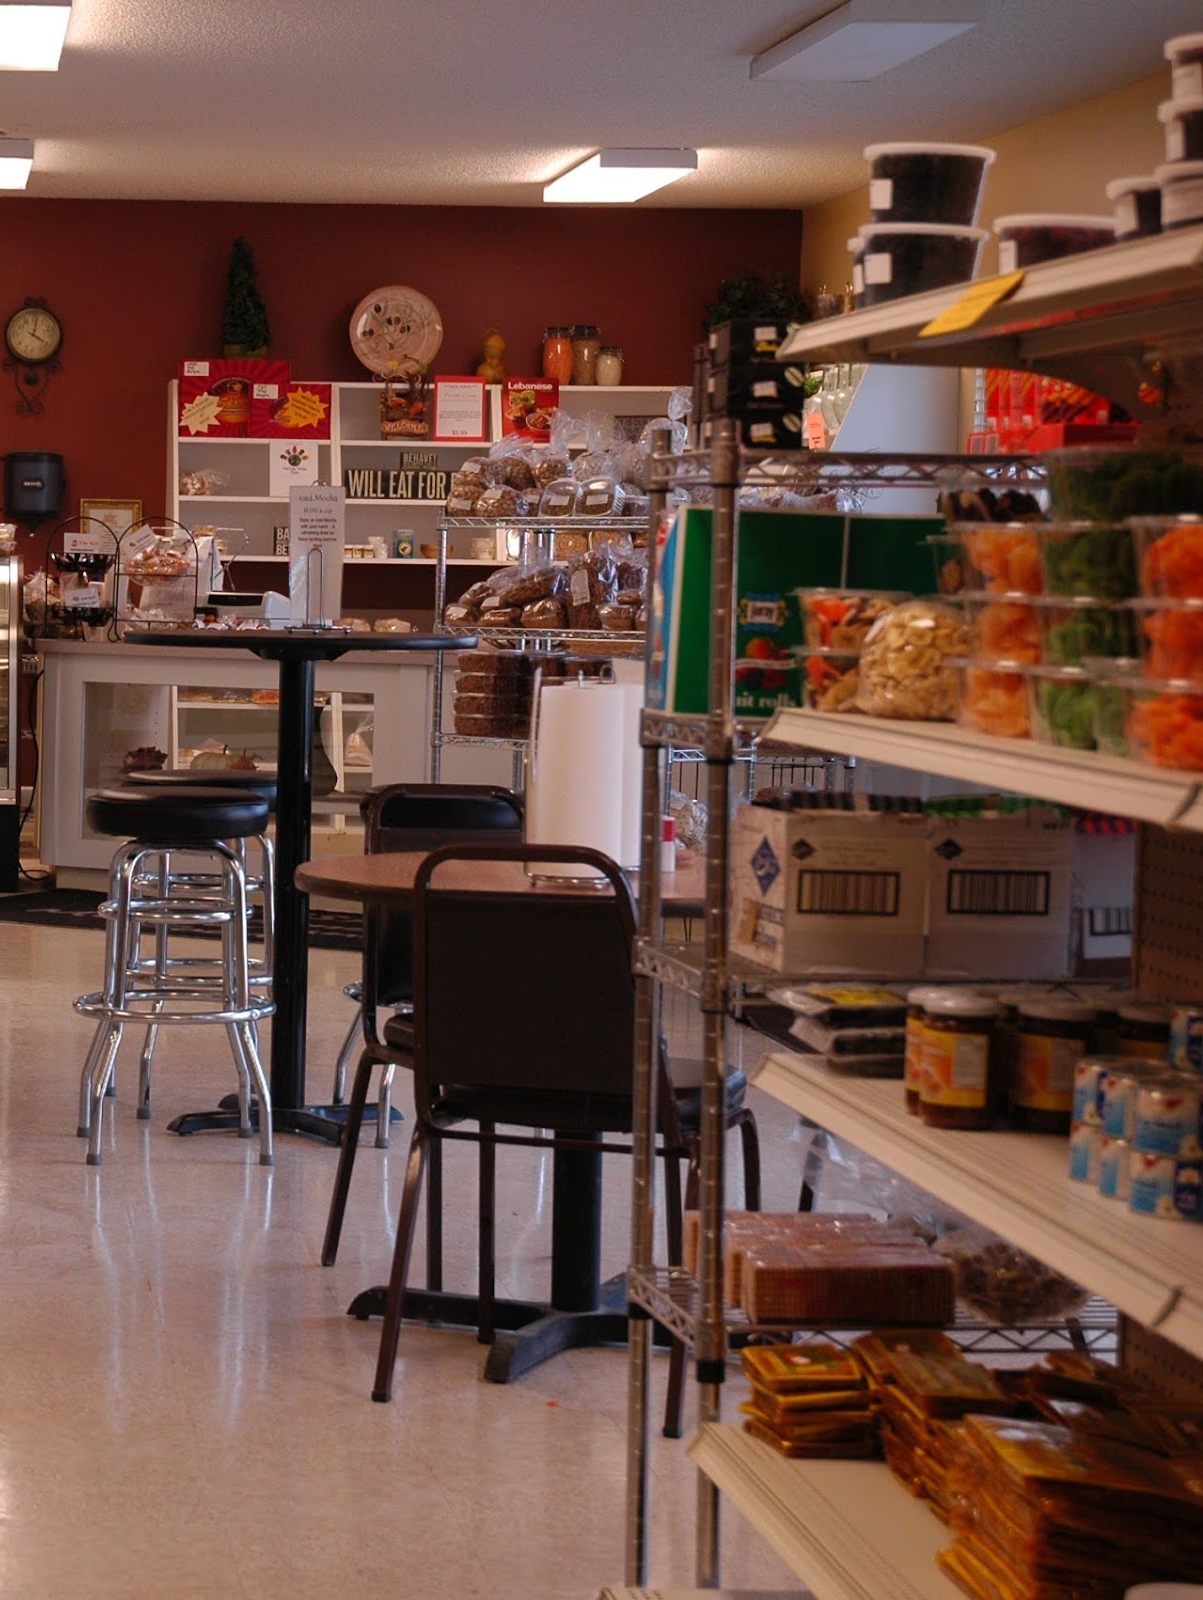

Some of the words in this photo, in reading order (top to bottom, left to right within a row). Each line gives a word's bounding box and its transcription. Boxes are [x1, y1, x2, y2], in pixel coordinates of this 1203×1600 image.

[507, 381, 553, 391] Lebanese
[403, 452, 436, 463] BEHAVE!
[348, 470, 385, 499] WILL
[389, 470, 415, 499] EAT
[418, 471, 446, 500] FOR
[314, 494, 338, 502] Mocha
[276, 527, 289, 540] BA
